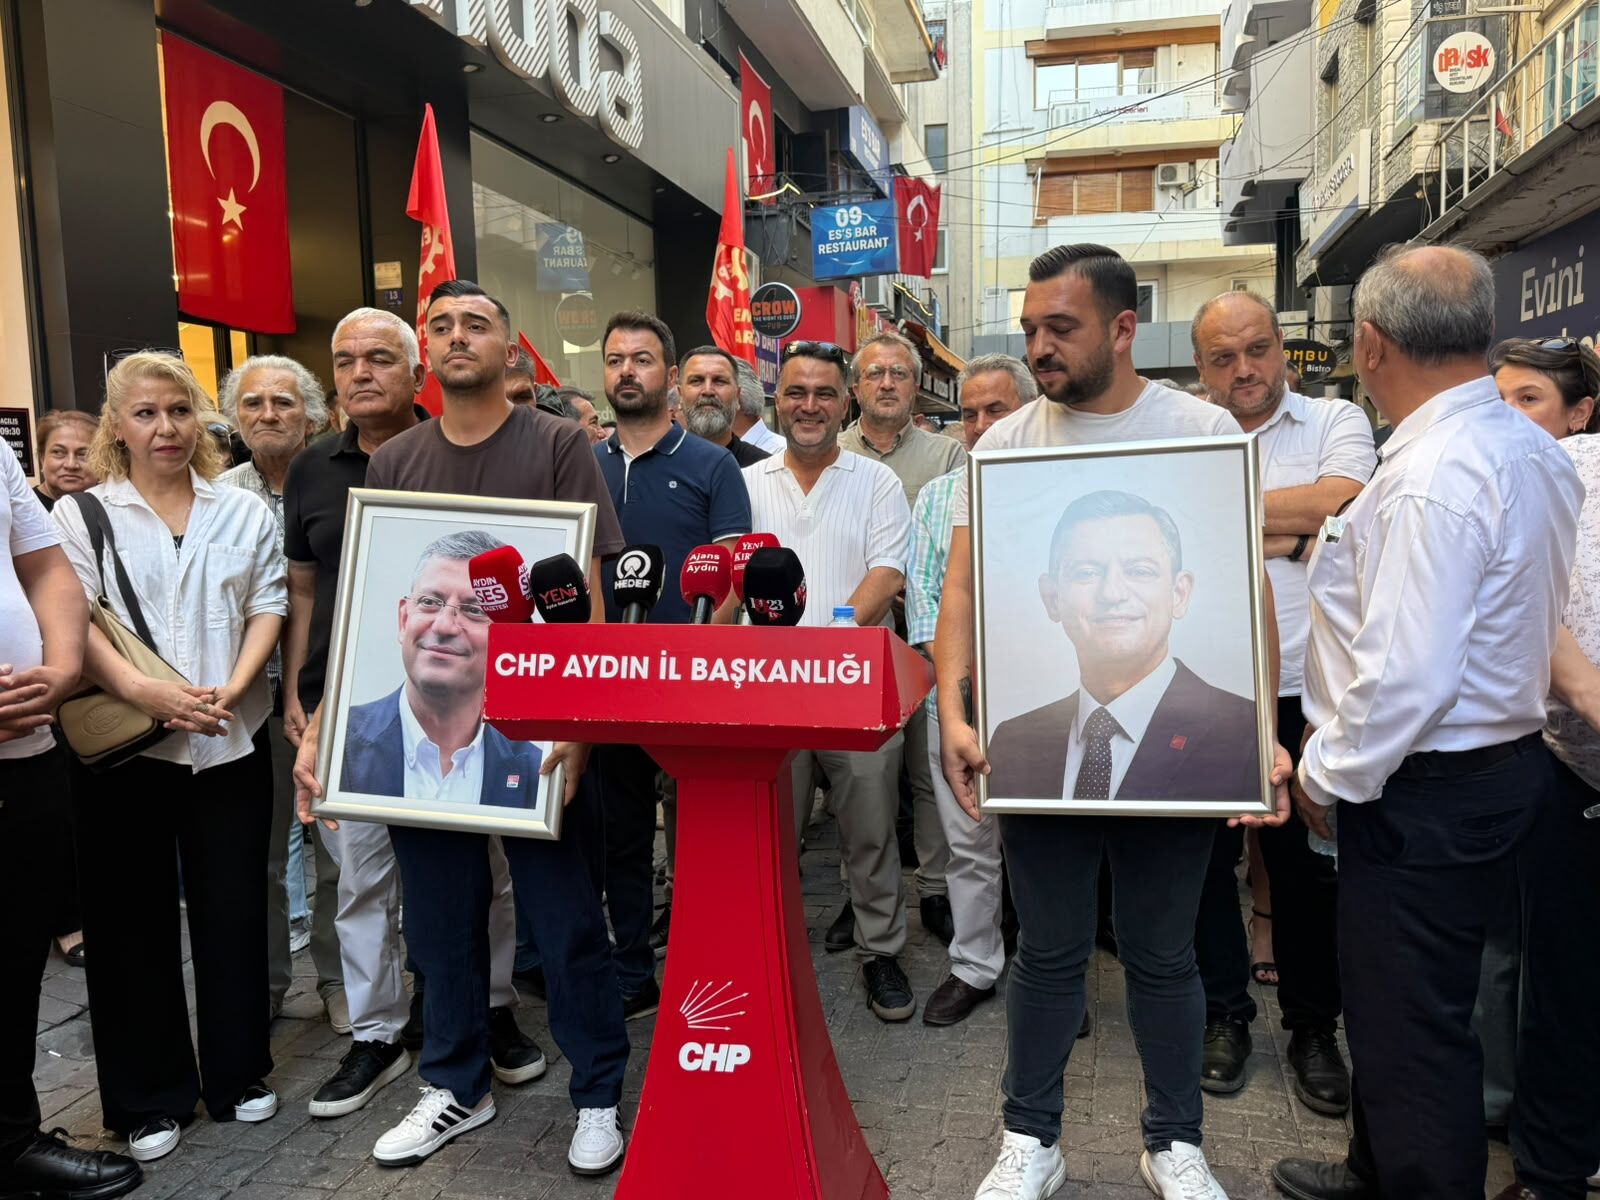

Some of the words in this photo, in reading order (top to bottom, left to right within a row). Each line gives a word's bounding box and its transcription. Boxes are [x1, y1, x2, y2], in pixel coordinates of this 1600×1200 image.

[835, 205, 862, 228] 09
[828, 228, 852, 241] ES'S
[855, 225, 877, 238] BAR
[818, 237, 889, 255] RESTAURANT
[1520, 245, 1585, 322] Evini
[751, 300, 796, 316] CROW
[1306, 363, 1331, 373] Bistro
[689, 553, 720, 561] Ajans
[686, 563, 718, 573] Aydın
[472, 576, 497, 588] AYDIN
[614, 579, 651, 590] HEDEF
[475, 587, 506, 603] SES
[495, 652, 556, 677] CHP
[562, 654, 649, 680] AYDIN
[659, 650, 682, 680] İL
[691, 653, 871, 689] BAŞKANLIĞI
[678, 1041, 751, 1073] CHP
